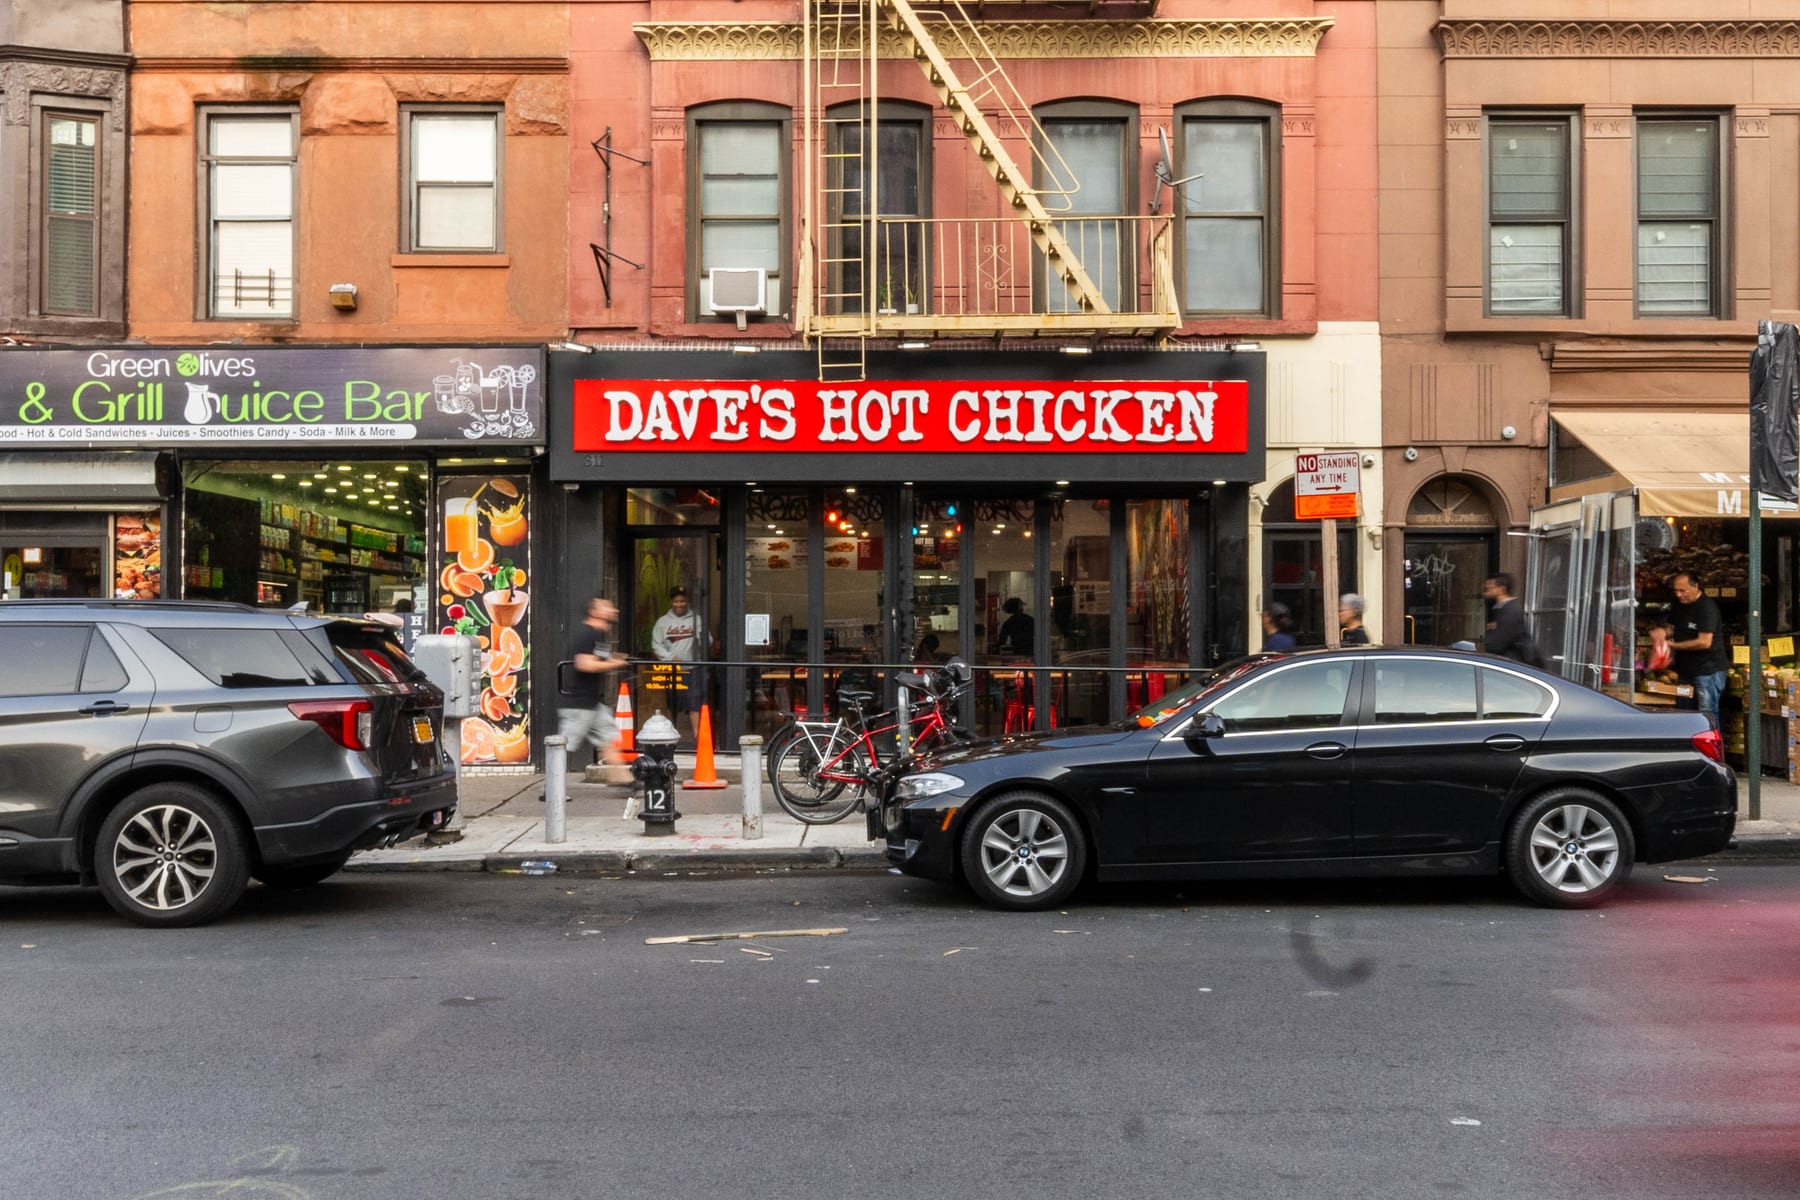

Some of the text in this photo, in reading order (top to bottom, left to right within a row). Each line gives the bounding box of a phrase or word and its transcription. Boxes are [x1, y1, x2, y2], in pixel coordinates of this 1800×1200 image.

[87, 352, 171, 378] Green
[18, 381, 54, 424] &
[71, 380, 164, 423] Grill
[345, 380, 432, 422] Bar
[603, 384, 1219, 442] DAVE'S HOT CHICKEN
[27, 428, 45, 438] Hot
[58, 428, 82, 438] Cold
[85, 428, 147, 438] Sandwiches
[156, 428, 190, 438] Juices
[199, 427, 254, 437] Smoothies
[257, 427, 290, 438] Candy
[299, 427, 326, 437] Soda
[335, 427, 356, 437] Milk
[359, 427, 367, 437] &
[370, 427, 396, 437] More
[1299, 457, 1358, 472] NO STANDING
[1310, 472, 1348, 484] ANY TIME
[646, 789, 666, 810] 12
